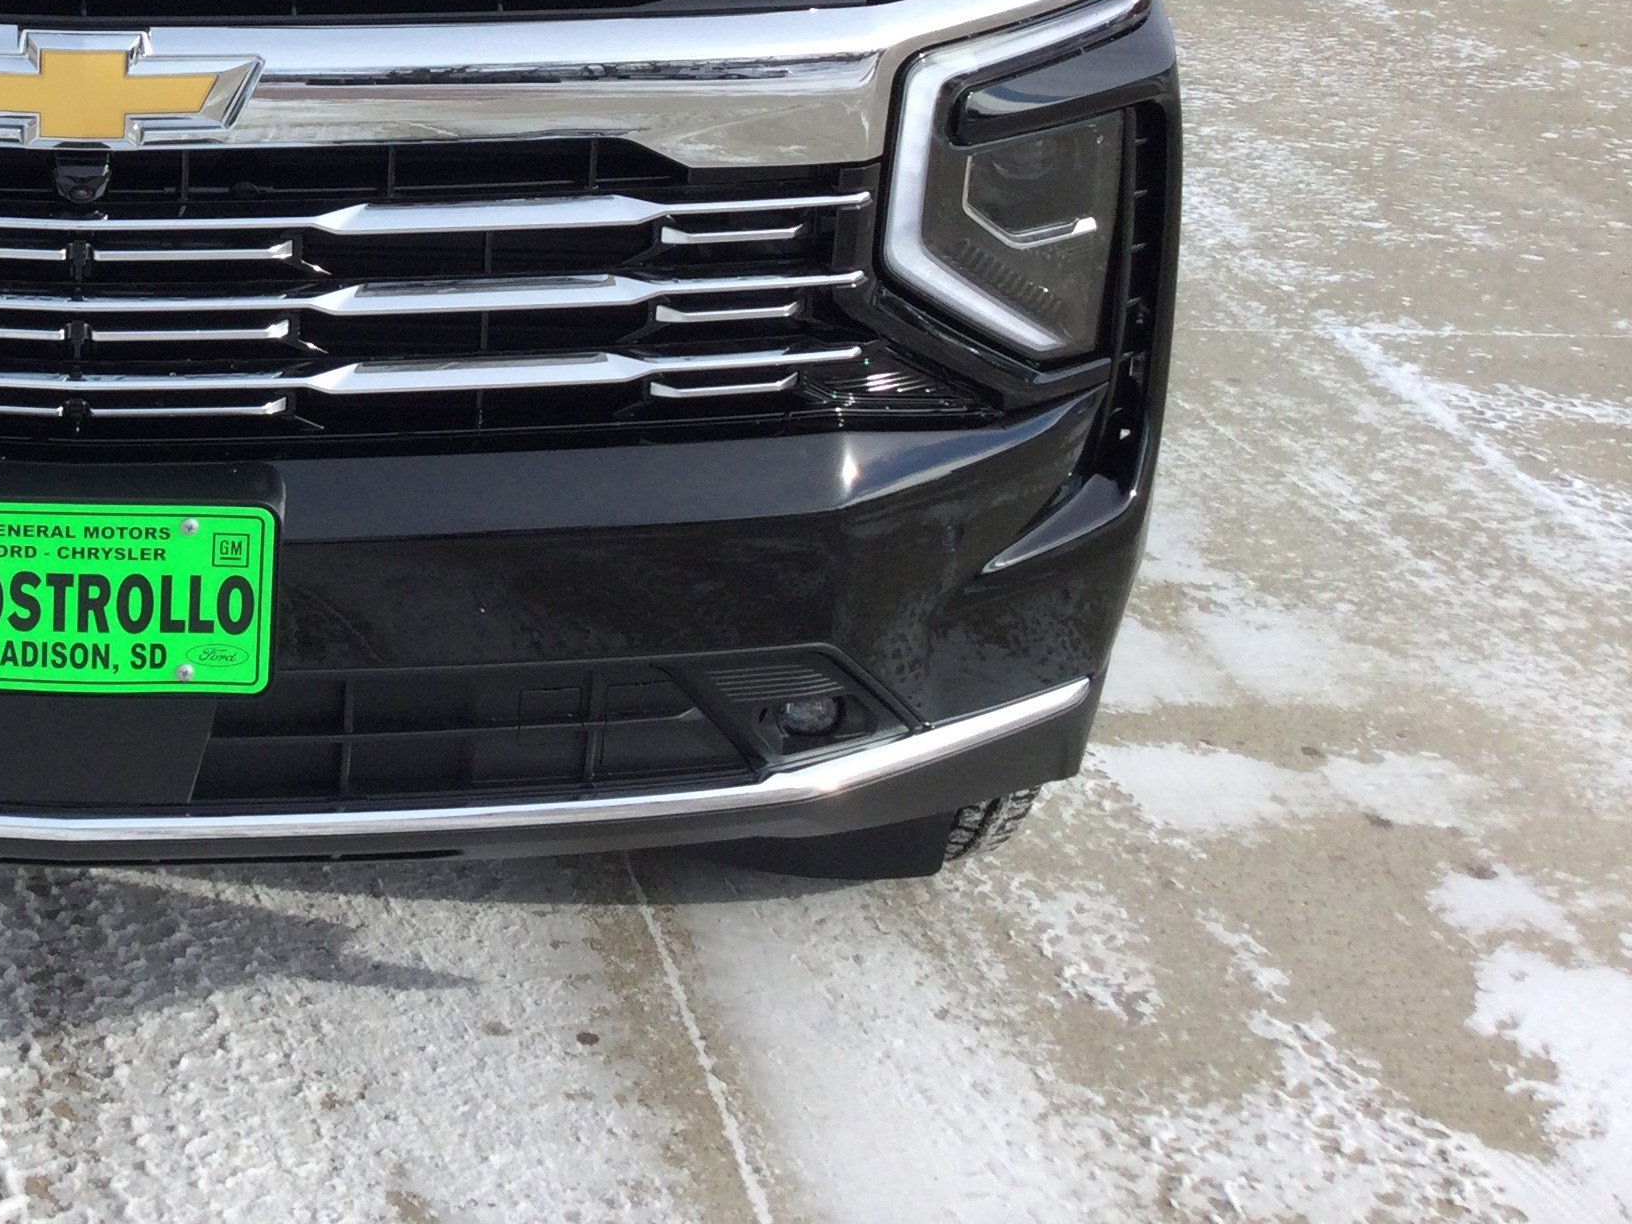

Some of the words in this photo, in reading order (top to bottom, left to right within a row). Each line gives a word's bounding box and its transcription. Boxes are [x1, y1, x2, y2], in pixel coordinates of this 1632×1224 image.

[83, 524, 171, 540] MOTORS
[57, 545, 167, 561] CHRYSLER
[219, 540, 242, 556] GM
[130, 643, 167, 670] SD
[198, 647, 237, 663] Ford
